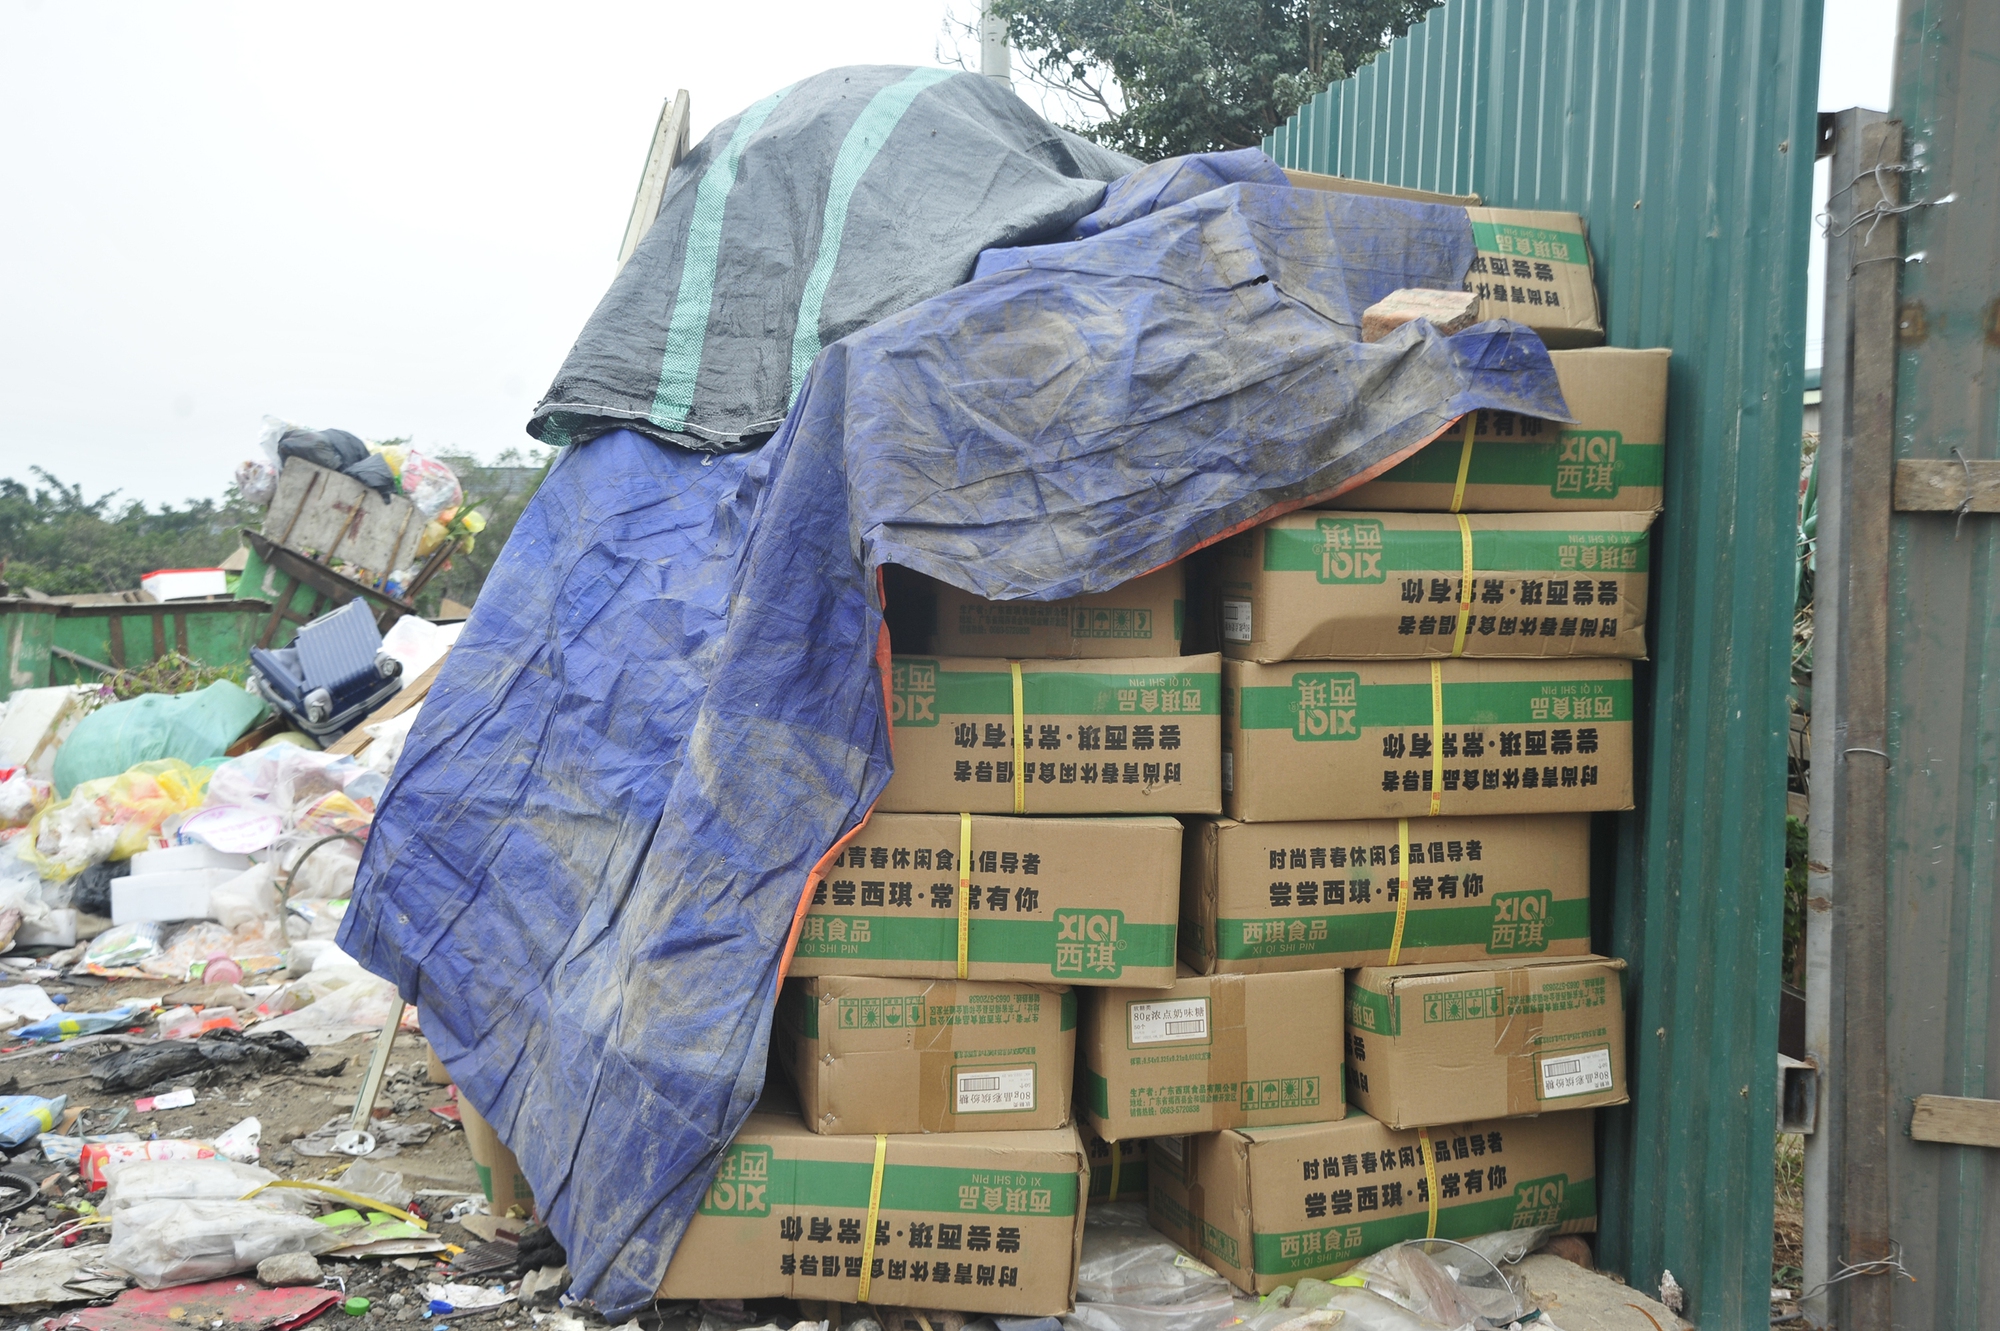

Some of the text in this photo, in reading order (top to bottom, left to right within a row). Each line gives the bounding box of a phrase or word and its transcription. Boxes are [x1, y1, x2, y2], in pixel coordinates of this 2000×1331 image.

[1495, 234, 1570, 261] 西琪食品
[1559, 436, 1617, 463] XIQI
[1556, 462, 1615, 493] 西琪
[1321, 523, 1383, 551] 西琪
[1568, 534, 1631, 545] XI QI SHI PIN
[1322, 551, 1381, 579] XIQI
[1558, 545, 1637, 569] 西琪食品
[1129, 675, 1192, 687] XI QI SHI PIN
[1298, 678, 1357, 709] 西琪
[1541, 683, 1604, 695] XI QI SHI PIN
[1118, 689, 1202, 713] 西琪食品
[1530, 696, 1614, 719] 西琪食品
[1298, 709, 1356, 736] XIQI
[1494, 895, 1548, 921] XIQI
[1058, 914, 1119, 942] XIQI
[1242, 920, 1328, 945] 西琪食品
[1491, 920, 1545, 949] 西琪
[804, 943, 816, 955] QI
[819, 944, 837, 954] SHI
[841, 944, 858, 954] PIN
[1055, 941, 1116, 974] 西琪
[1252, 942, 1315, 955] XI QI SHI PIN
[1133, 1006, 1205, 1022] 80g浓点奶味糖
[972, 1174, 1041, 1187] XI QI SHI PIN
[958, 1185, 1052, 1213] 西琪食品
[1516, 1180, 1564, 1210] XIQI
[1512, 1205, 1561, 1230] 西琪
[1279, 1227, 1363, 1258] 西琪食品
[1291, 1251, 1350, 1268] XI QI SHI PIN
